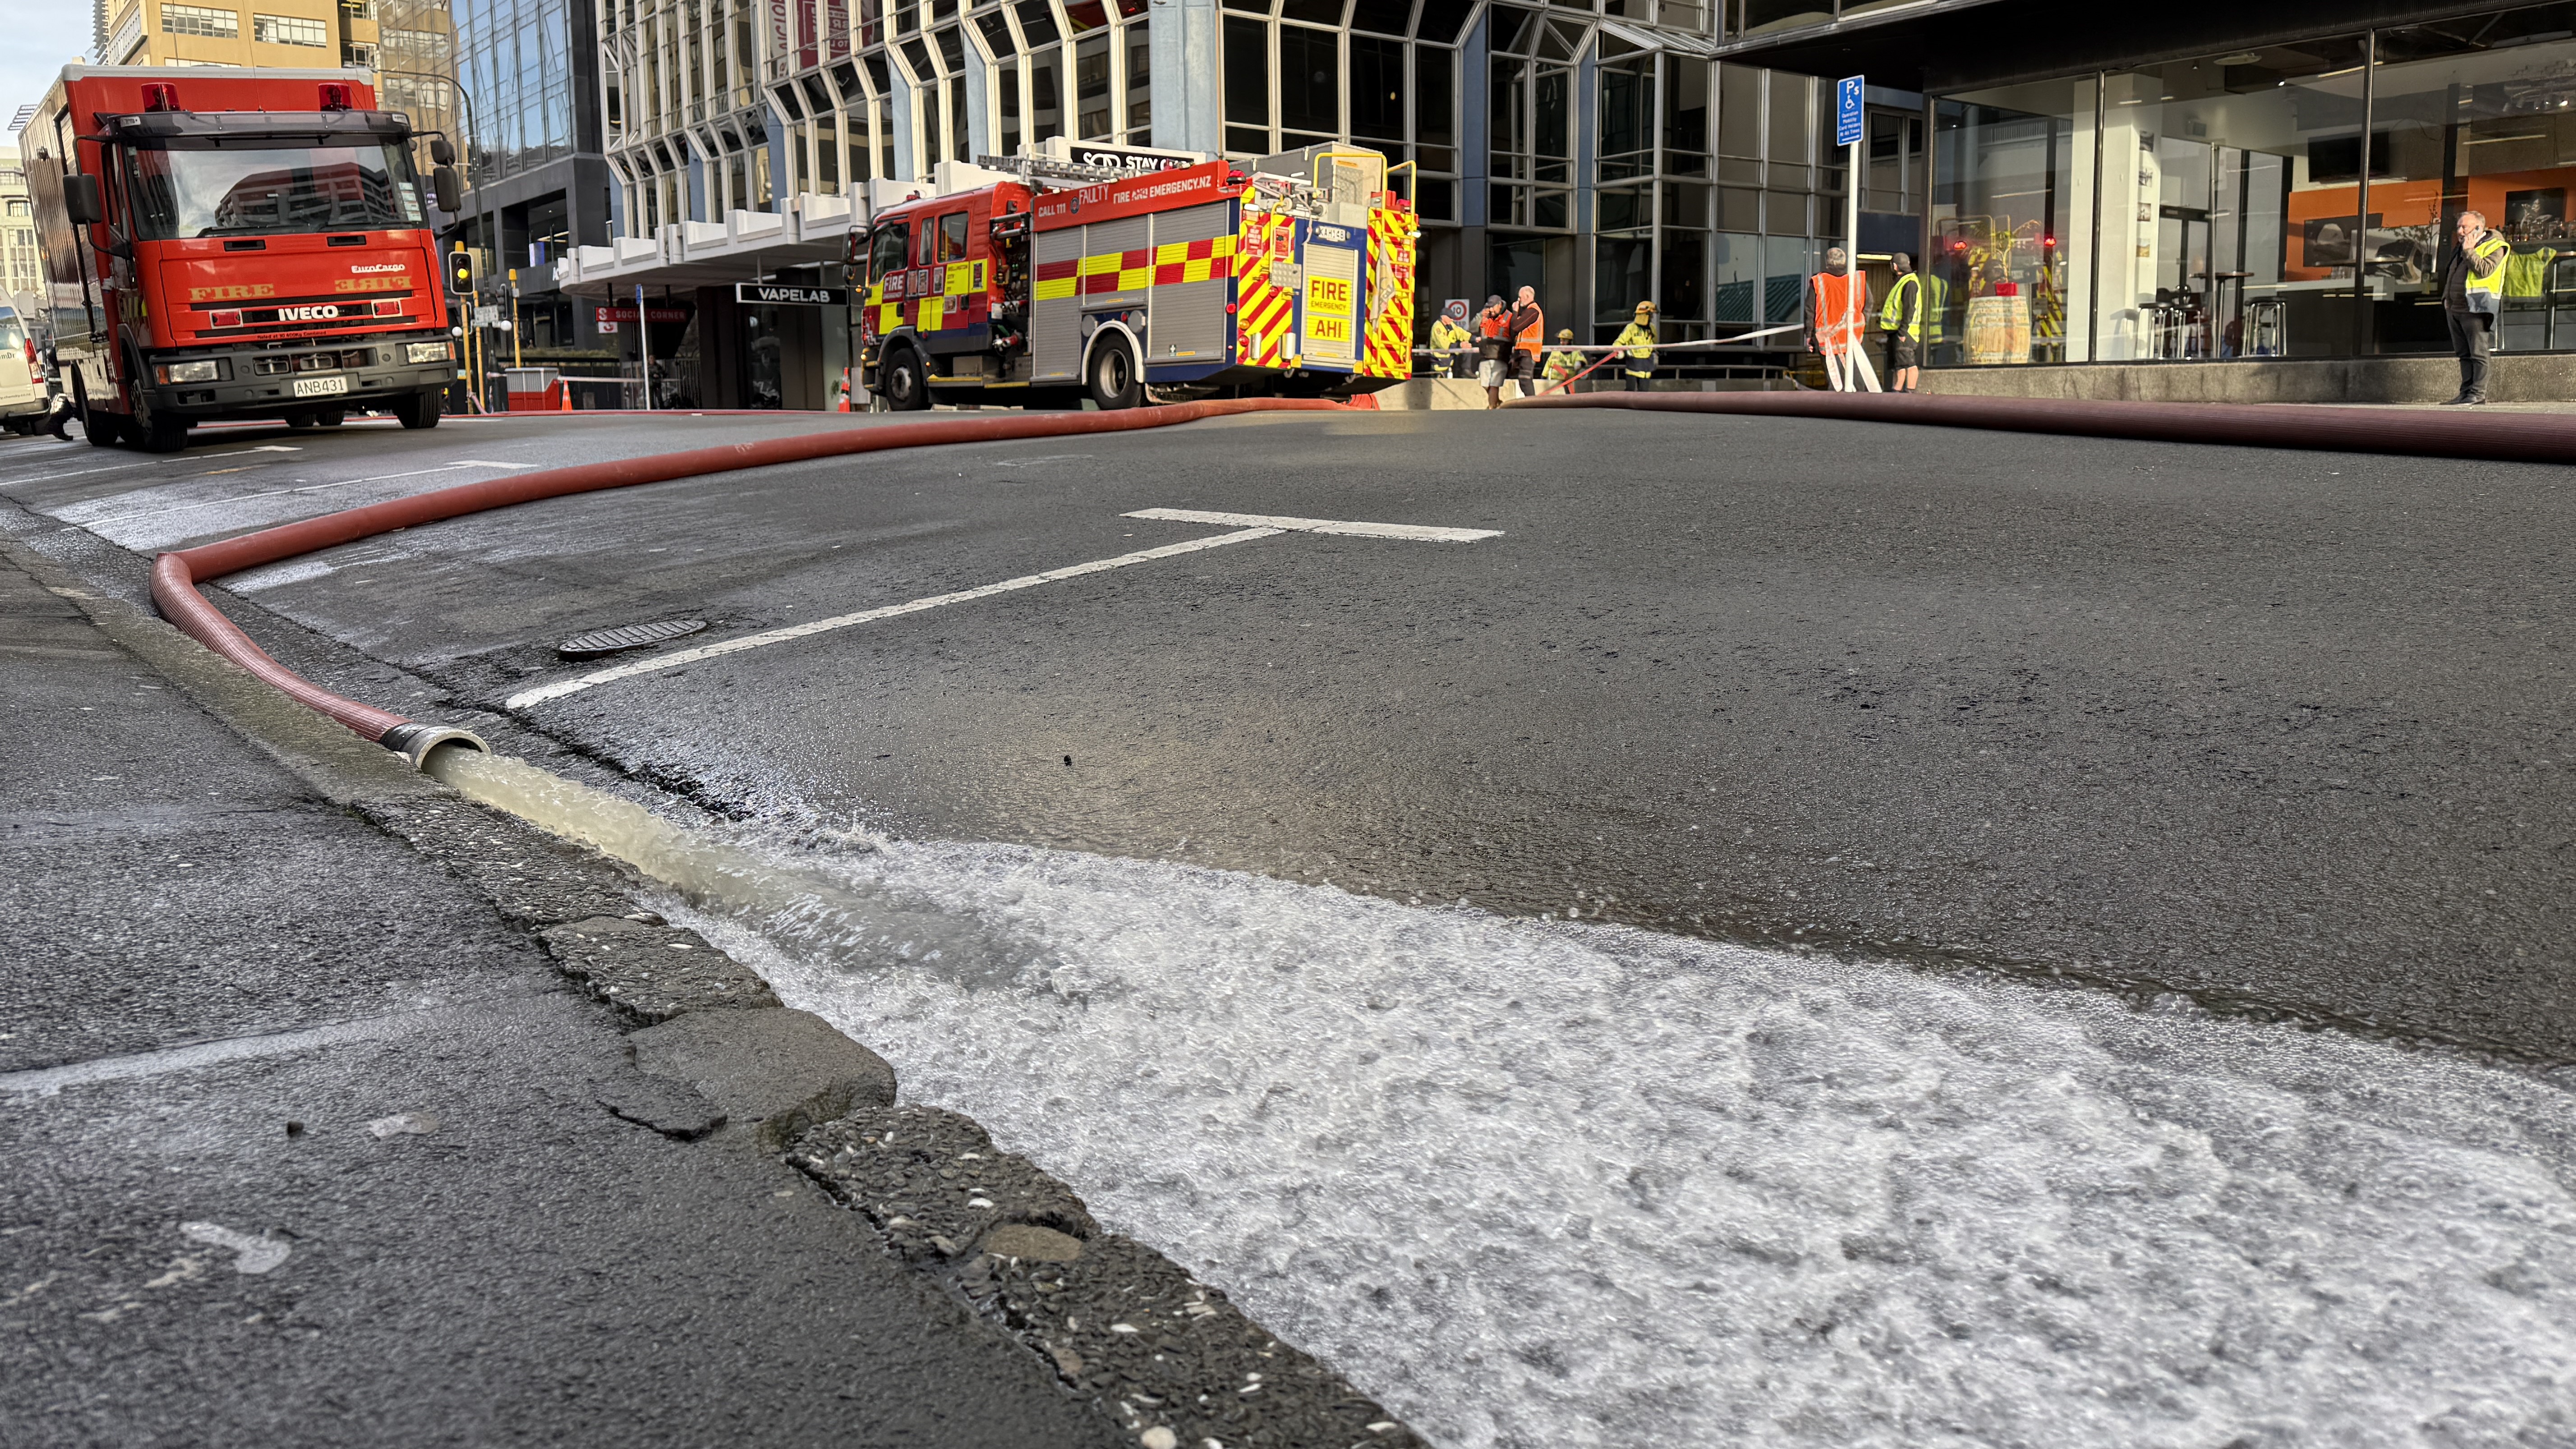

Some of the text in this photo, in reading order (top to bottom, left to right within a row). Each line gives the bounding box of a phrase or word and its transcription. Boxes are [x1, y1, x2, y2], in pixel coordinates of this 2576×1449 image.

[1126, 156, 1158, 170] STAY
[1079, 184, 1109, 205] FAULTY
[1113, 191, 1130, 204] FIRE
[1150, 175, 1211, 198] EMERGENCY.NZ
[1039, 203, 1066, 217] CALL 111
[351, 263, 405, 273] EuroCargo
[884, 274, 904, 292] FIRE
[1311, 280, 1347, 301] FIRE
[188, 283, 274, 301] FIRE
[758, 287, 830, 303] VAPELAB
[278, 305, 338, 322] IVECO
[1311, 300, 1346, 311] EMERGENCY
[616, 310, 685, 320] SOCI CORNER
[1315, 320, 1341, 338] AHI
[297, 379, 344, 395] ANB431
